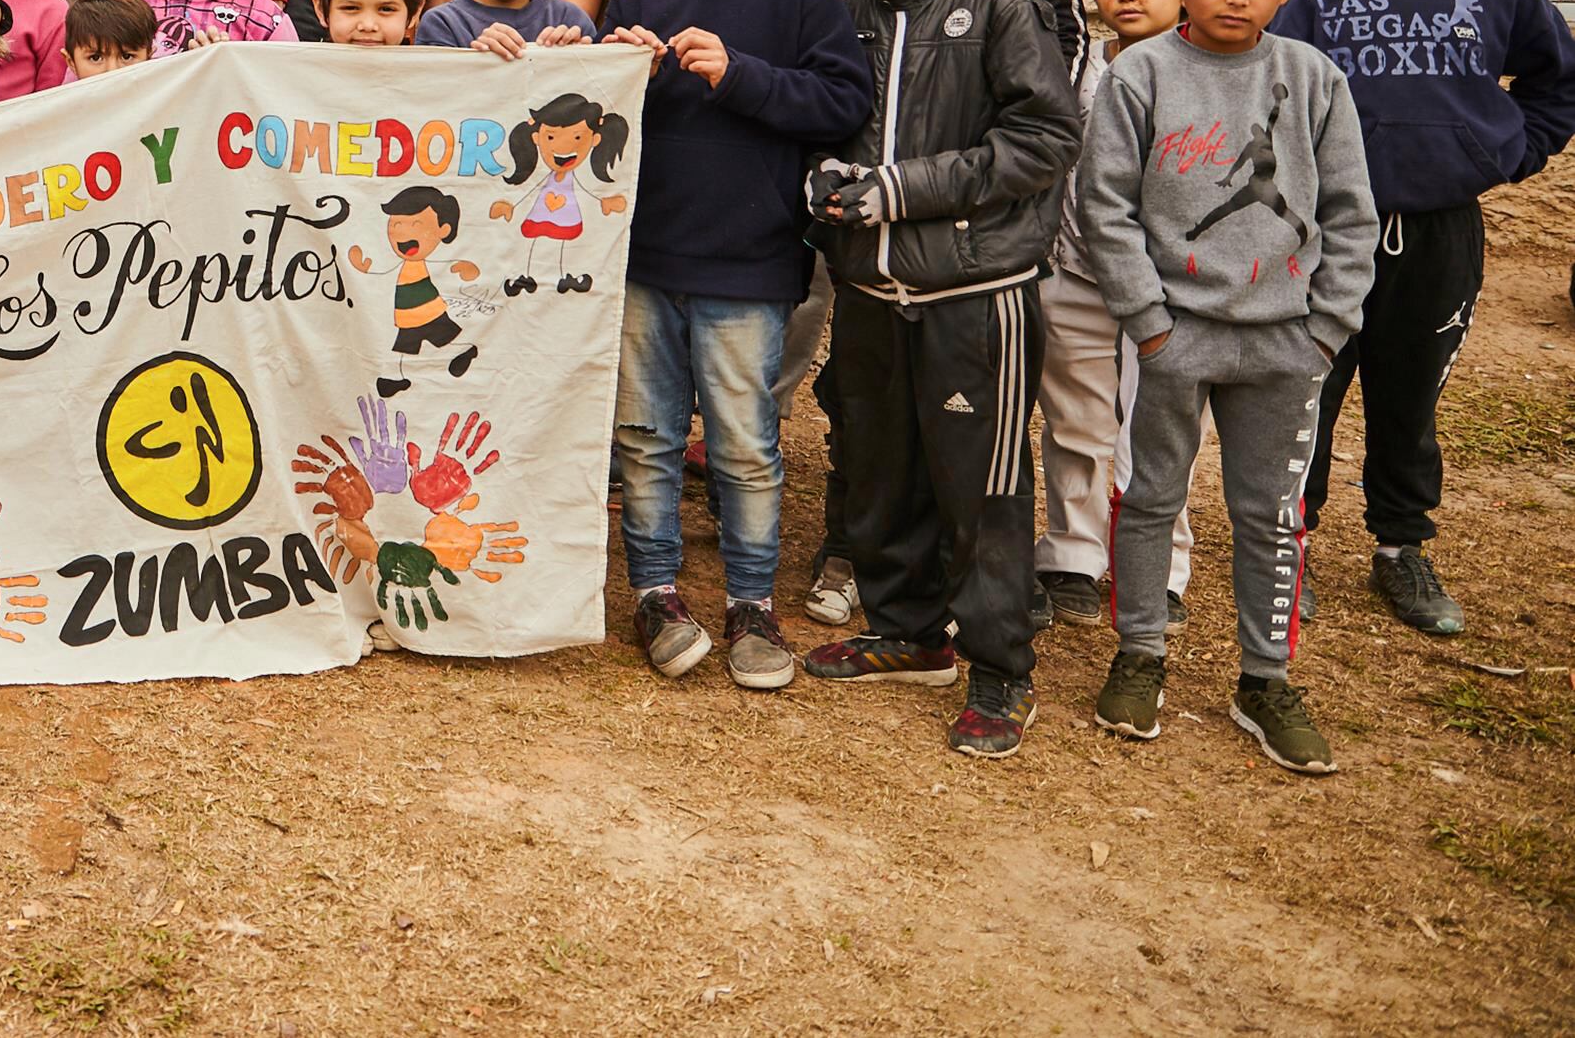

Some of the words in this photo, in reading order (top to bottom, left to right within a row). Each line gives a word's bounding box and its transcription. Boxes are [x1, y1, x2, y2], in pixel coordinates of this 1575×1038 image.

[1322, 12, 1451, 43] VEGAS
[139, 126, 181, 185] Y
[217, 112, 507, 178] COMEDOR
[1155, 120, 1235, 175] Flight
[943, 403, 975, 413] adidas
[56, 532, 338, 648] ZUMBA
